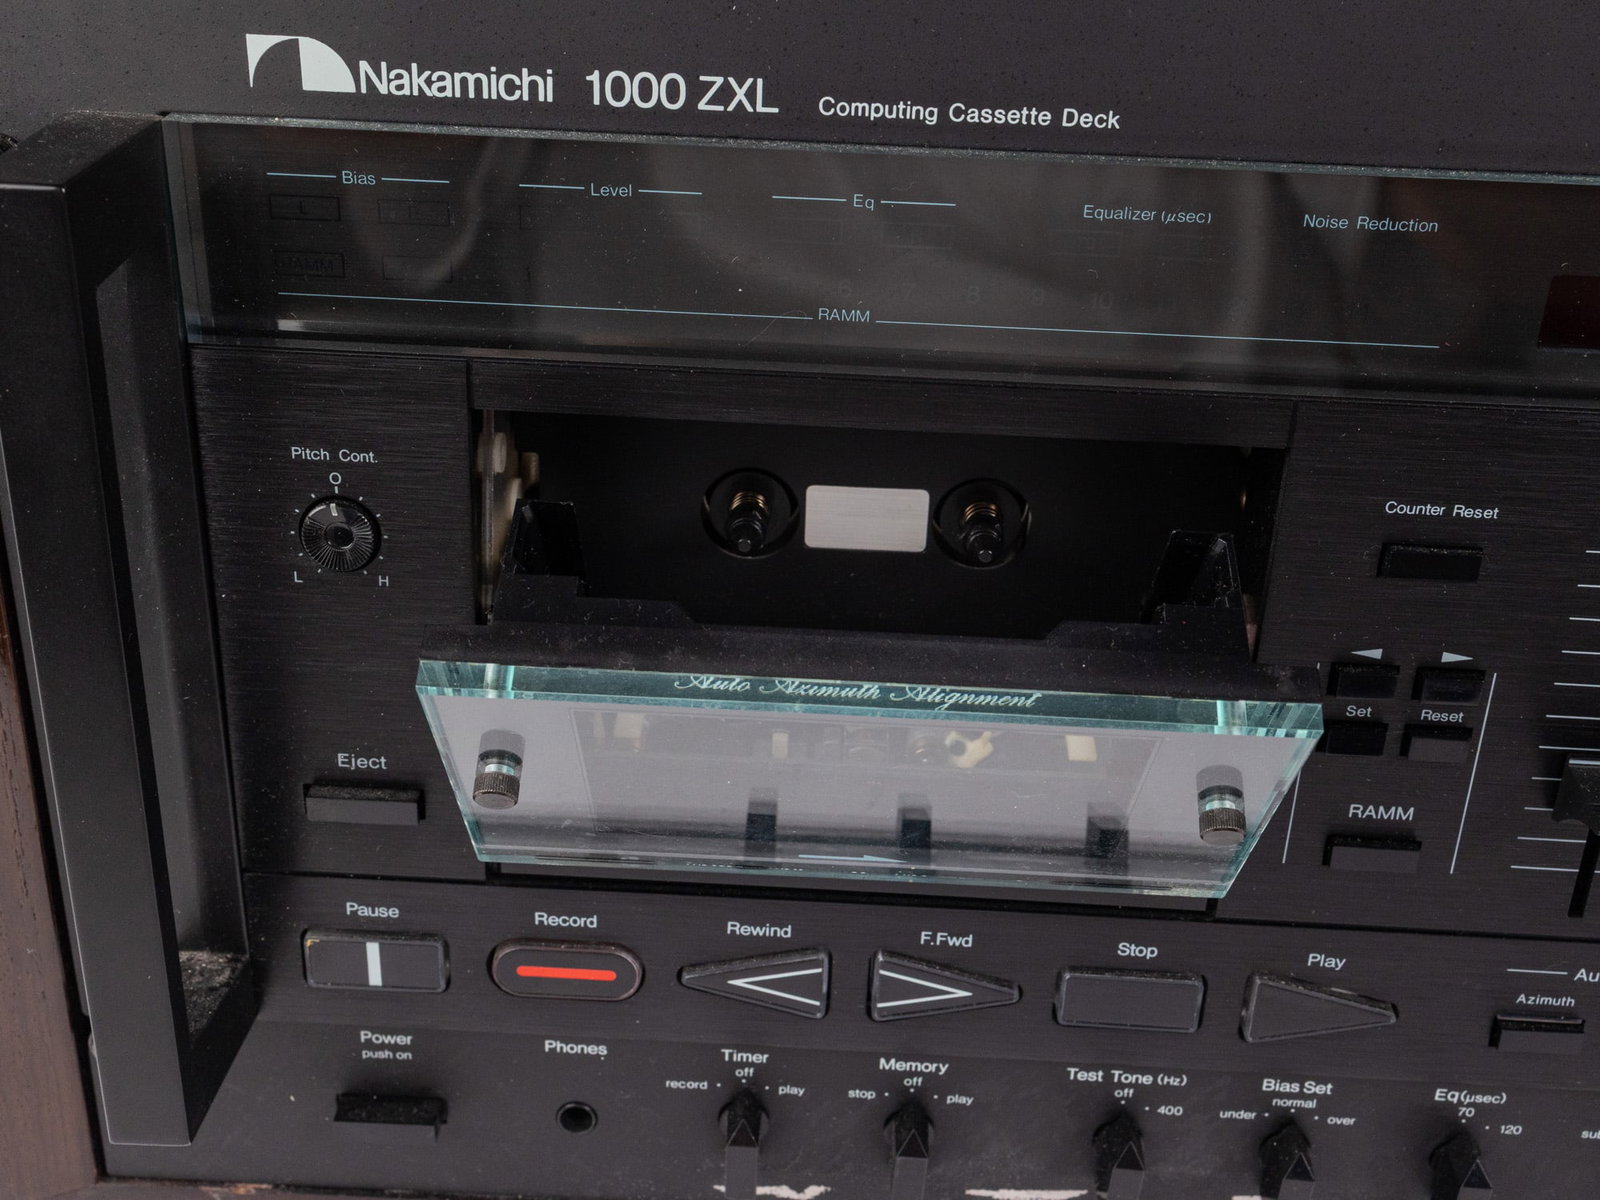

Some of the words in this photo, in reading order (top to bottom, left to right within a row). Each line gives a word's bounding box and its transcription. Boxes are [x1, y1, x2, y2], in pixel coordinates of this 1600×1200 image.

[358, 60, 554, 103] Nakamichi
[585, 69, 687, 110] 1000
[697, 75, 780, 114] ZXL
[818, 96, 939, 126] Computing
[948, 102, 1052, 126] Cassette
[1061, 107, 1121, 130] Deck
[341, 170, 376, 186] Bias
[590, 182, 632, 198] Level
[853, 193, 875, 212] Eq
[1083, 204, 1157, 222] Equalizer
[1303, 213, 1349, 229] Noise
[1356, 215, 1439, 233] Reduction
[818, 307, 870, 323] RAMM
[290, 446, 330, 461] Pitch
[338, 448, 378, 465] Cont.
[1385, 500, 1446, 516] Counter
[1452, 504, 1500, 520] Reset
[293, 570, 304, 583] L
[378, 575, 389, 587] H
[673, 675, 751, 692] Auto
[759, 679, 883, 700] Azimuth
[889, 685, 1043, 712] Alignment
[1345, 704, 1372, 718] Set
[1420, 709, 1465, 723] Reset
[337, 752, 387, 771] Eject
[1348, 803, 1415, 821] RAMM
[345, 901, 400, 919] Pause
[534, 911, 598, 929] Record
[726, 921, 792, 938] Rewind
[920, 931, 973, 948] F.Fwd
[1117, 942, 1159, 960] Stop
[1307, 953, 1347, 971] Play
[1515, 993, 1575, 1008] Azimuth
[359, 1030, 413, 1046] Power
[361, 1049, 393, 1060] push
[395, 1051, 413, 1061] on
[544, 1039, 608, 1056] Phones
[720, 1048, 770, 1064] Timer
[734, 1066, 755, 1077] off
[879, 1057, 949, 1076] Memory
[665, 1079, 708, 1090] record
[903, 1076, 923, 1087] off
[1066, 1067, 1104, 1082] Test
[1110, 1069, 1154, 1085] Tone
[1157, 1073, 1188, 1087] (Hz)
[778, 1084, 806, 1098] play
[847, 1088, 876, 1101] stop
[1114, 1087, 1134, 1098] off
[1261, 1078, 1299, 1094] Bias
[1301, 1080, 1333, 1095] Set
[946, 1094, 974, 1107] play
[1272, 1098, 1317, 1109] normal
[1157, 1105, 1184, 1117] 400
[1219, 1109, 1257, 1121] under
[1458, 1106, 1476, 1118] 70
[1326, 1116, 1356, 1126] over
[1500, 1124, 1523, 1136] 120
